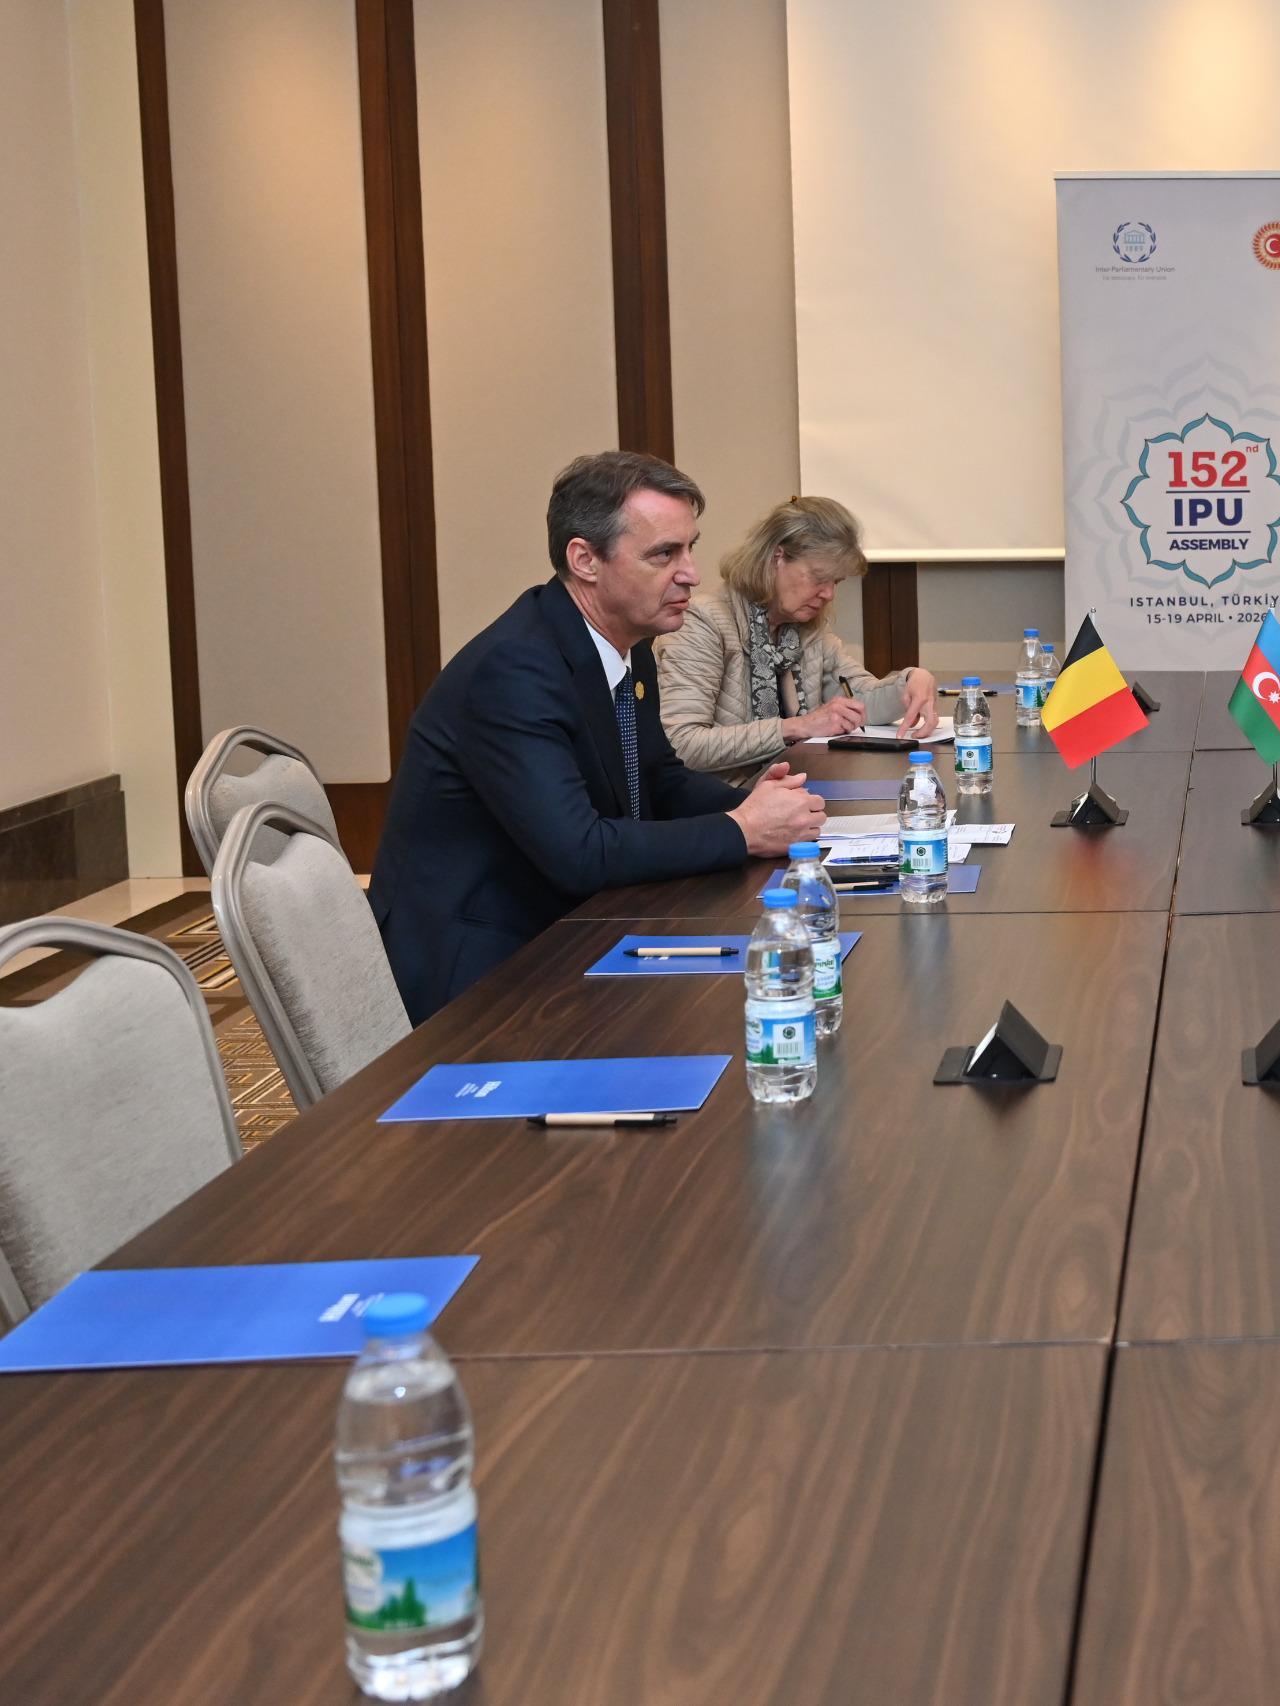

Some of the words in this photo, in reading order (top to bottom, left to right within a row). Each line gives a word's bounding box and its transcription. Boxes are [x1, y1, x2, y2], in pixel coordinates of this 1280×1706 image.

[1168, 450, 1248, 488] 152
[1245, 444, 1259, 453] nd
[1174, 498, 1243, 526] IPU
[1169, 538, 1249, 551] ASSEMBLY
[1130, 596, 1214, 607] ISTANBUL,
[1147, 614, 1182, 624] 15-19
[1186, 613, 1224, 623] APRIL
